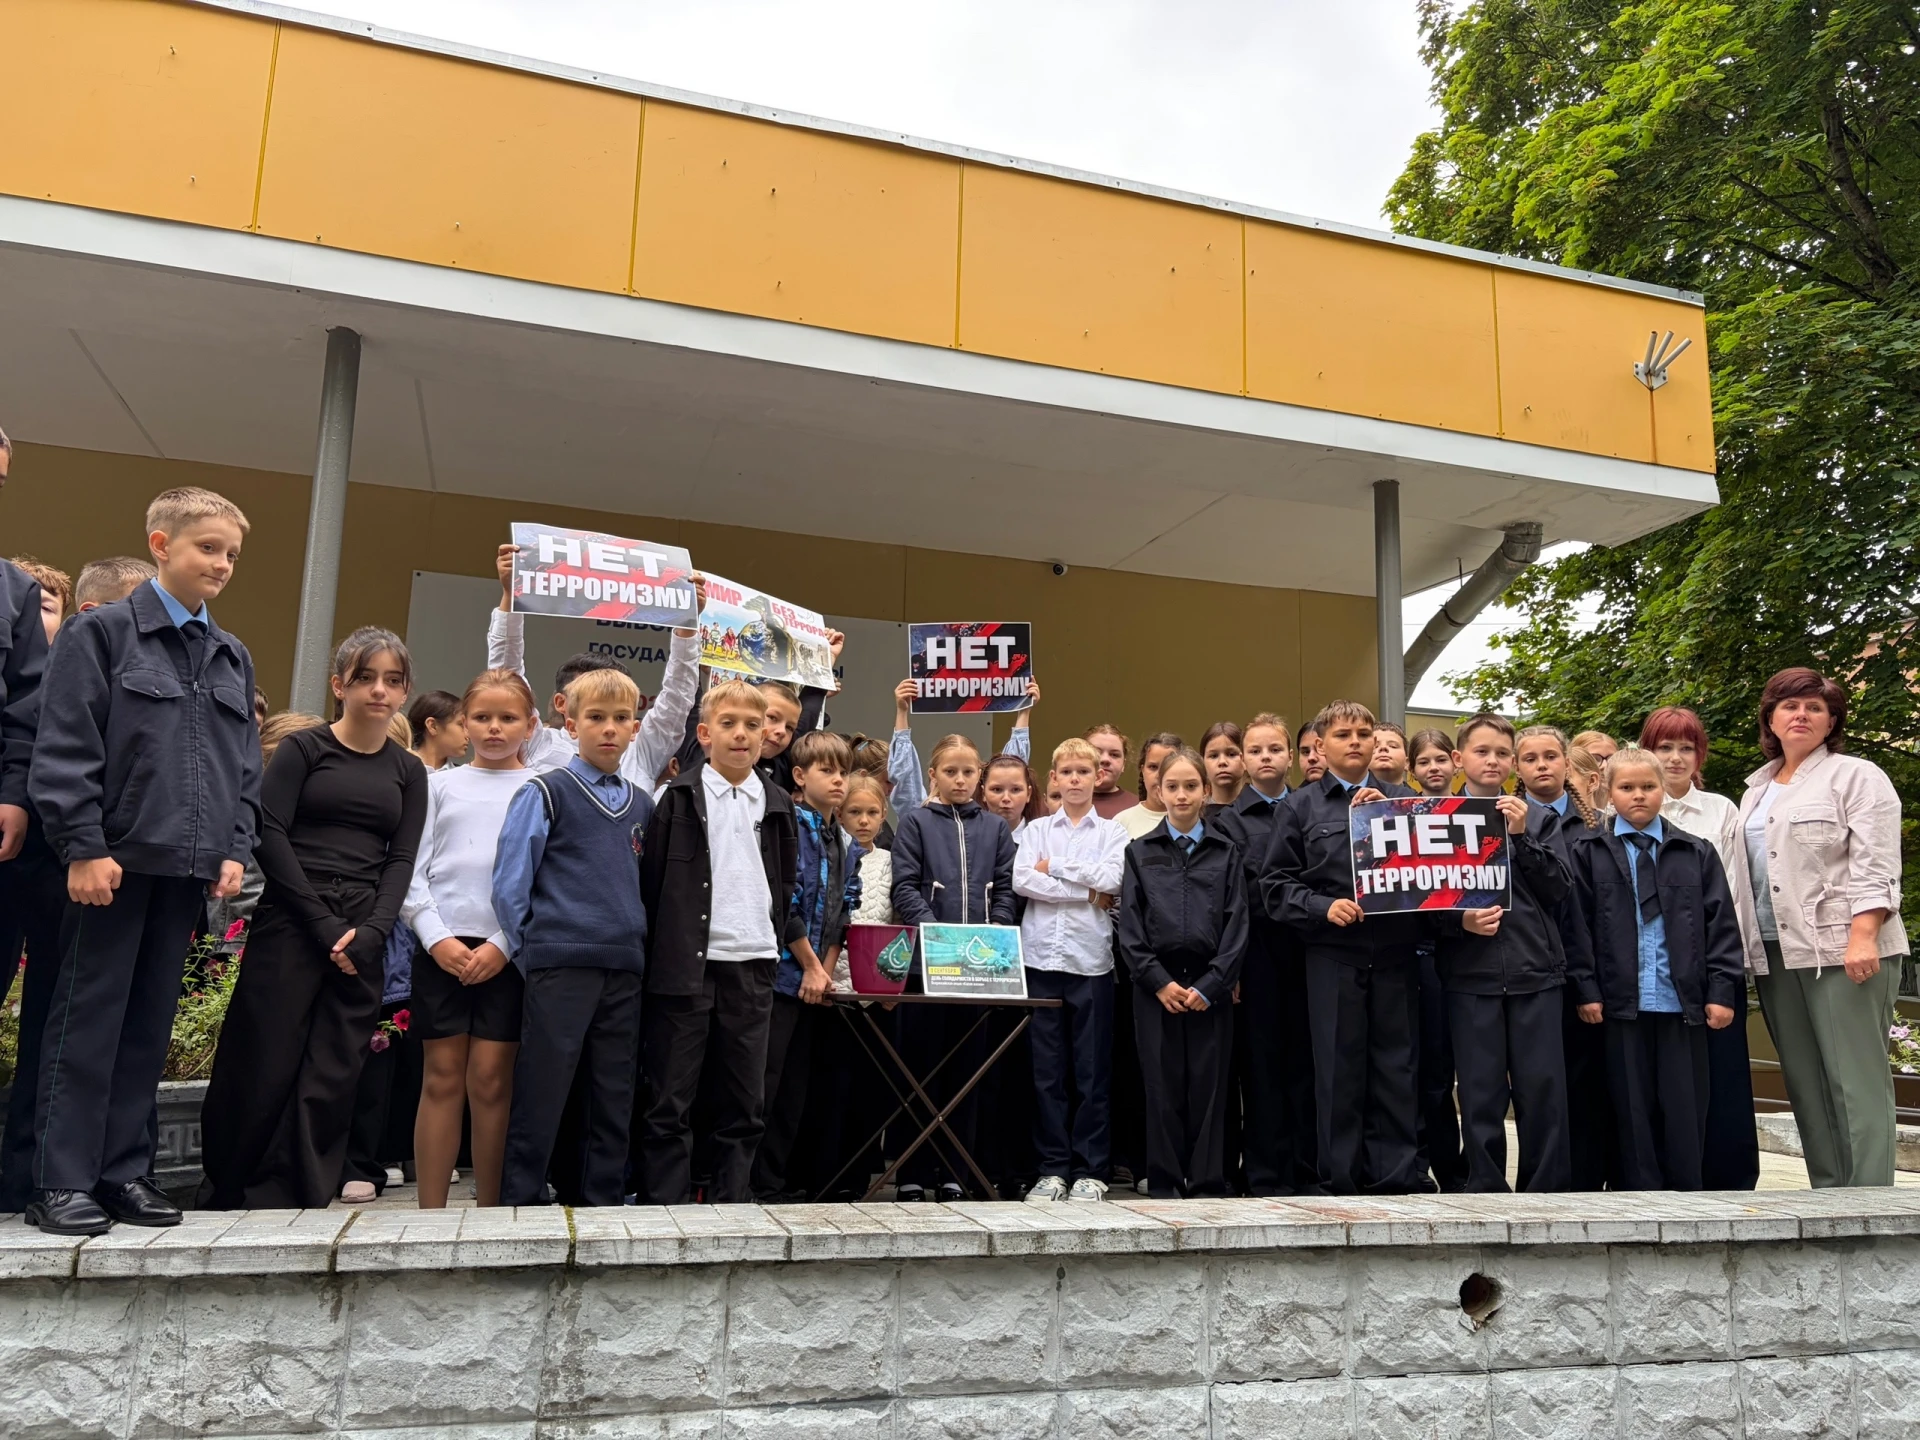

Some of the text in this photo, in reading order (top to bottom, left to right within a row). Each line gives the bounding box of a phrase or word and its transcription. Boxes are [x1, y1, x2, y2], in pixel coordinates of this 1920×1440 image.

[538, 533, 668, 578] НЕТ
[518, 569, 691, 610] ТЕРРОРИЗМУ
[703, 580, 796, 620] МИР БЕЗ
[784, 618, 825, 637] ТЕРРОРА
[589, 642, 670, 663] ГОСУДА
[926, 636, 1016, 670] НЕТ
[915, 676, 1030, 698] ТЕРРОРИЗМУ
[1370, 814, 1486, 859] НЕТ
[1358, 864, 1507, 894] ТЕРРОРИЗМУ
